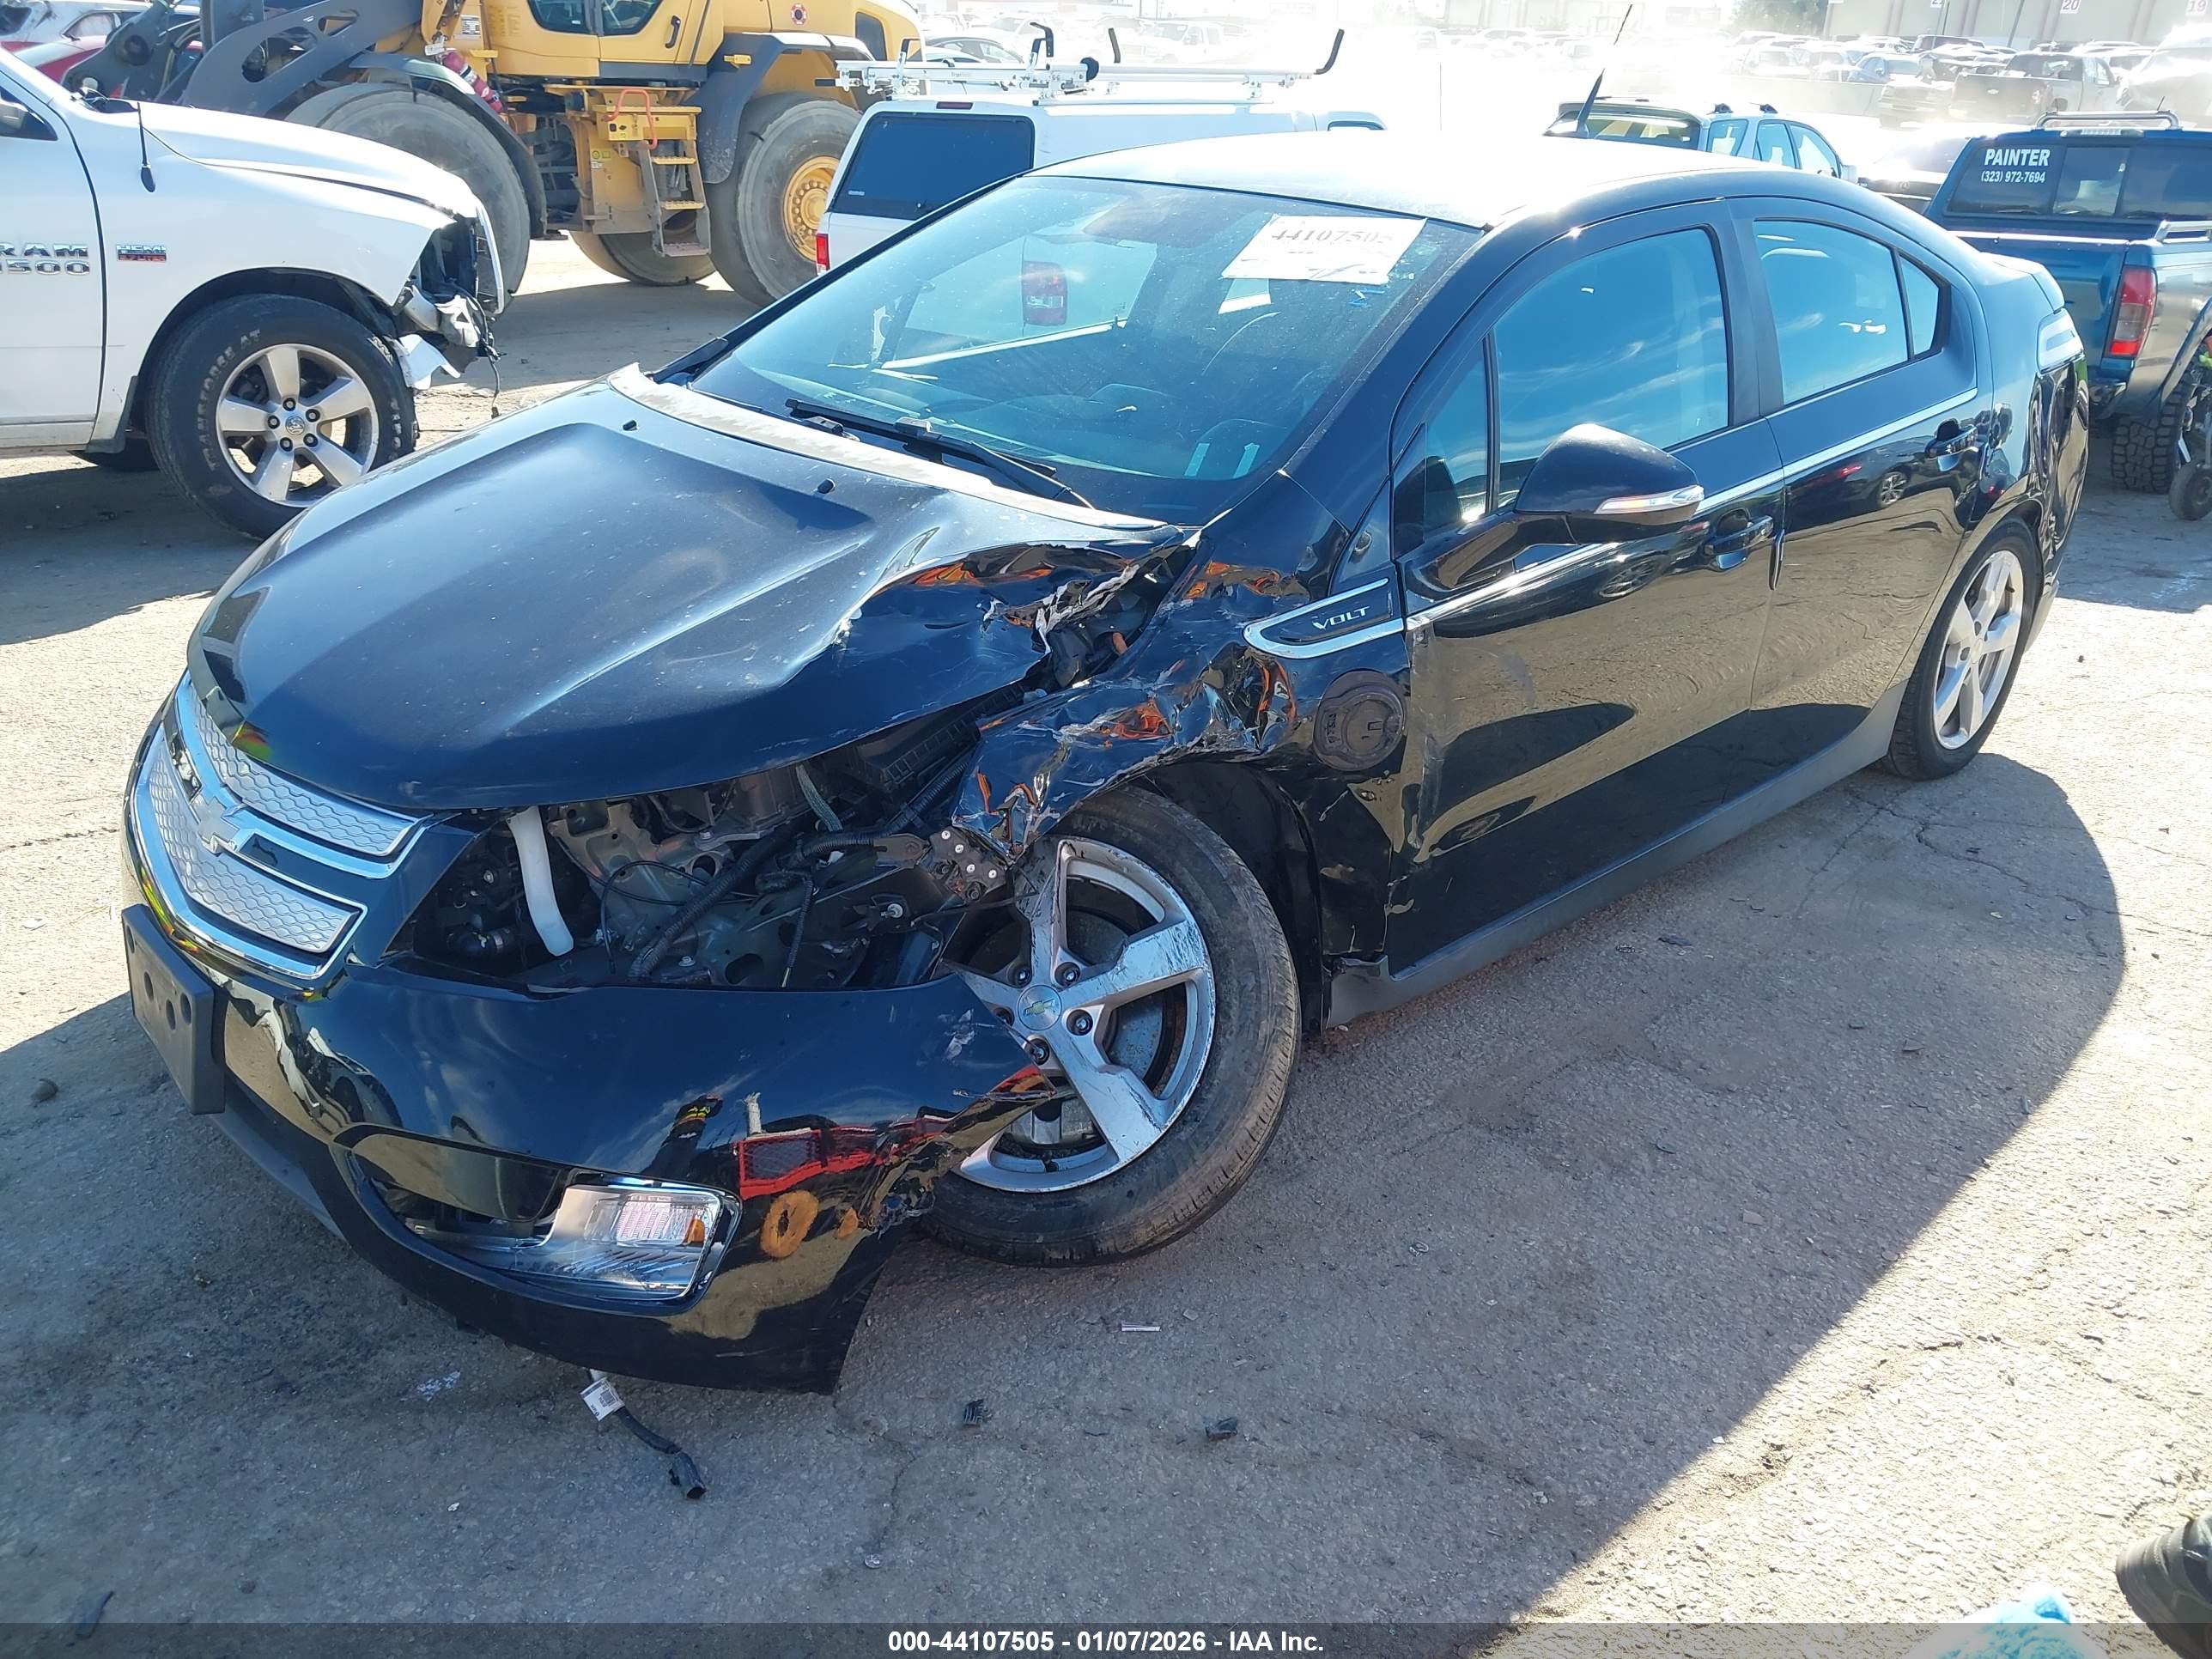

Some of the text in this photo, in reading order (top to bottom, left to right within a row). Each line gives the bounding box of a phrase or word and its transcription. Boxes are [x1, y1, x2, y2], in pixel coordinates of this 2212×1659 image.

[2062, 0, 2079, 9] 20
[1984, 149, 2051, 167] PAINTER
[1980, 171, 2046, 183] (323) 972-7694
[116, 245, 167, 254] HEMI
[0, 259, 90, 275] 500
[1311, 606, 1370, 629] VOLT
